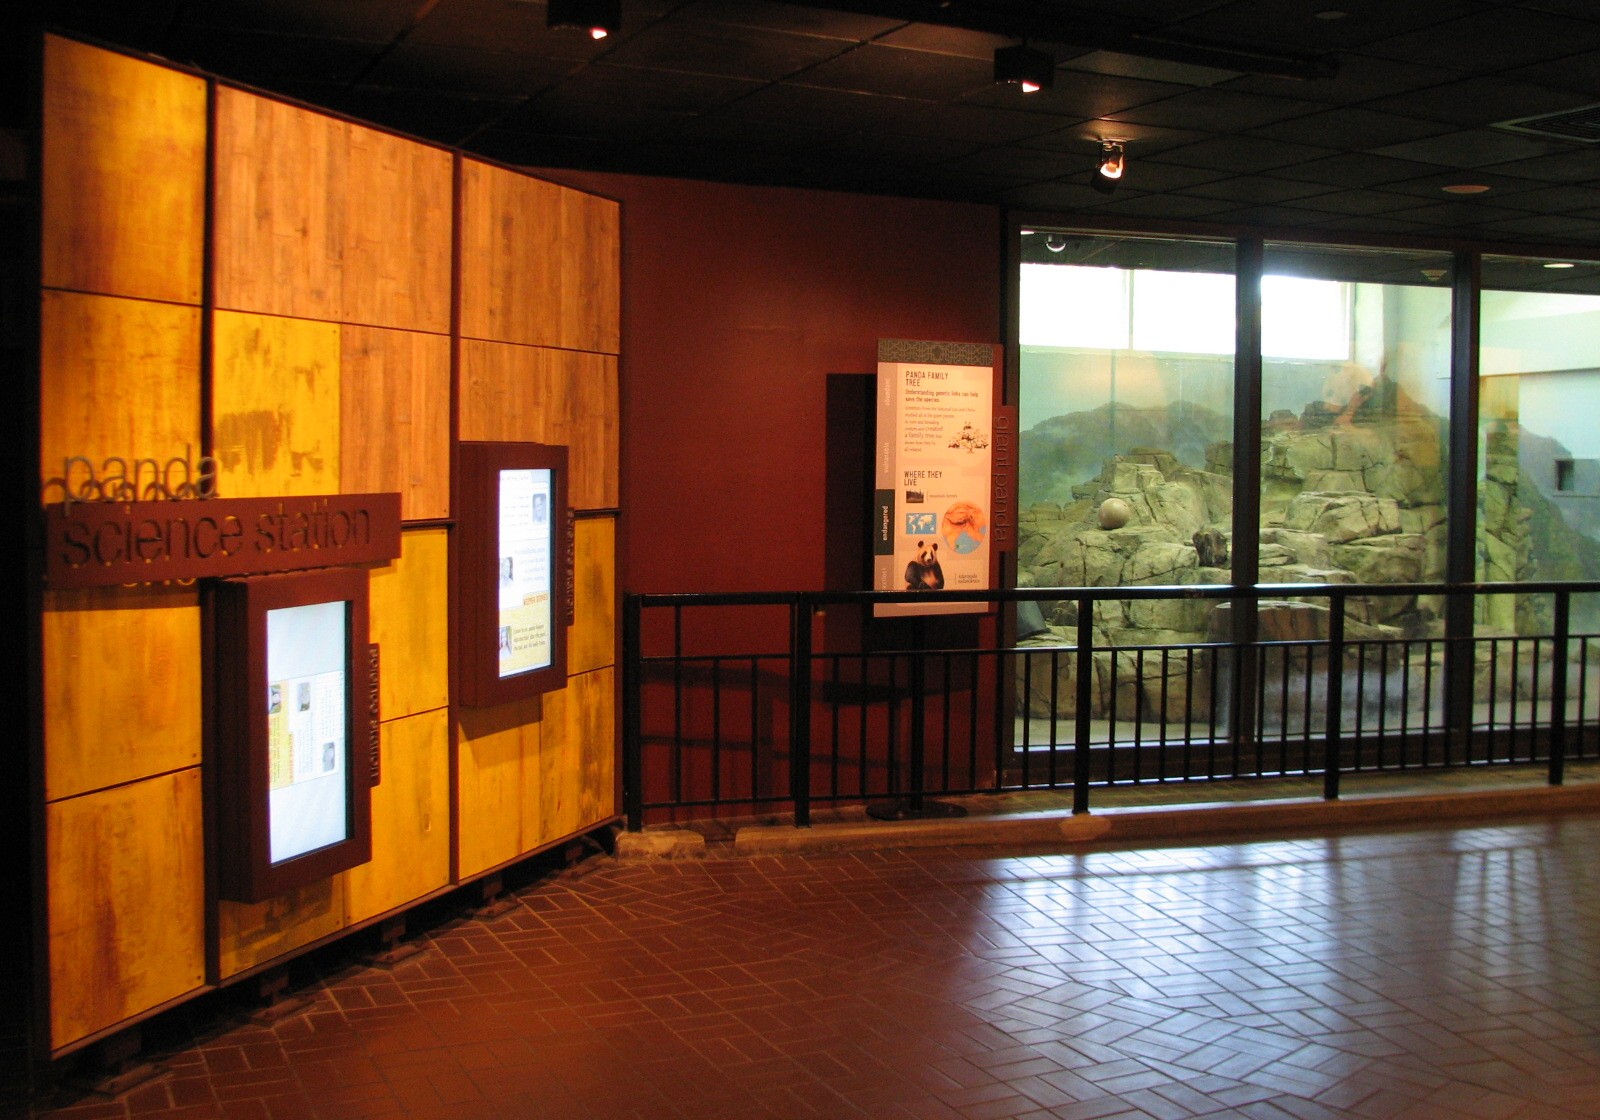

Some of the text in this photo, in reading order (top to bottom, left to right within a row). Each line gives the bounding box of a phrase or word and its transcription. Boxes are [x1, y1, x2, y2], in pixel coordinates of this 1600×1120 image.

[906, 370, 948, 380] PANDA FAMILY
[64, 443, 218, 517] panda
[904, 478, 917, 486] LIVE
[927, 471, 942, 479] THEY
[993, 416, 1012, 542] giant panda
[61, 499, 371, 568] science station
